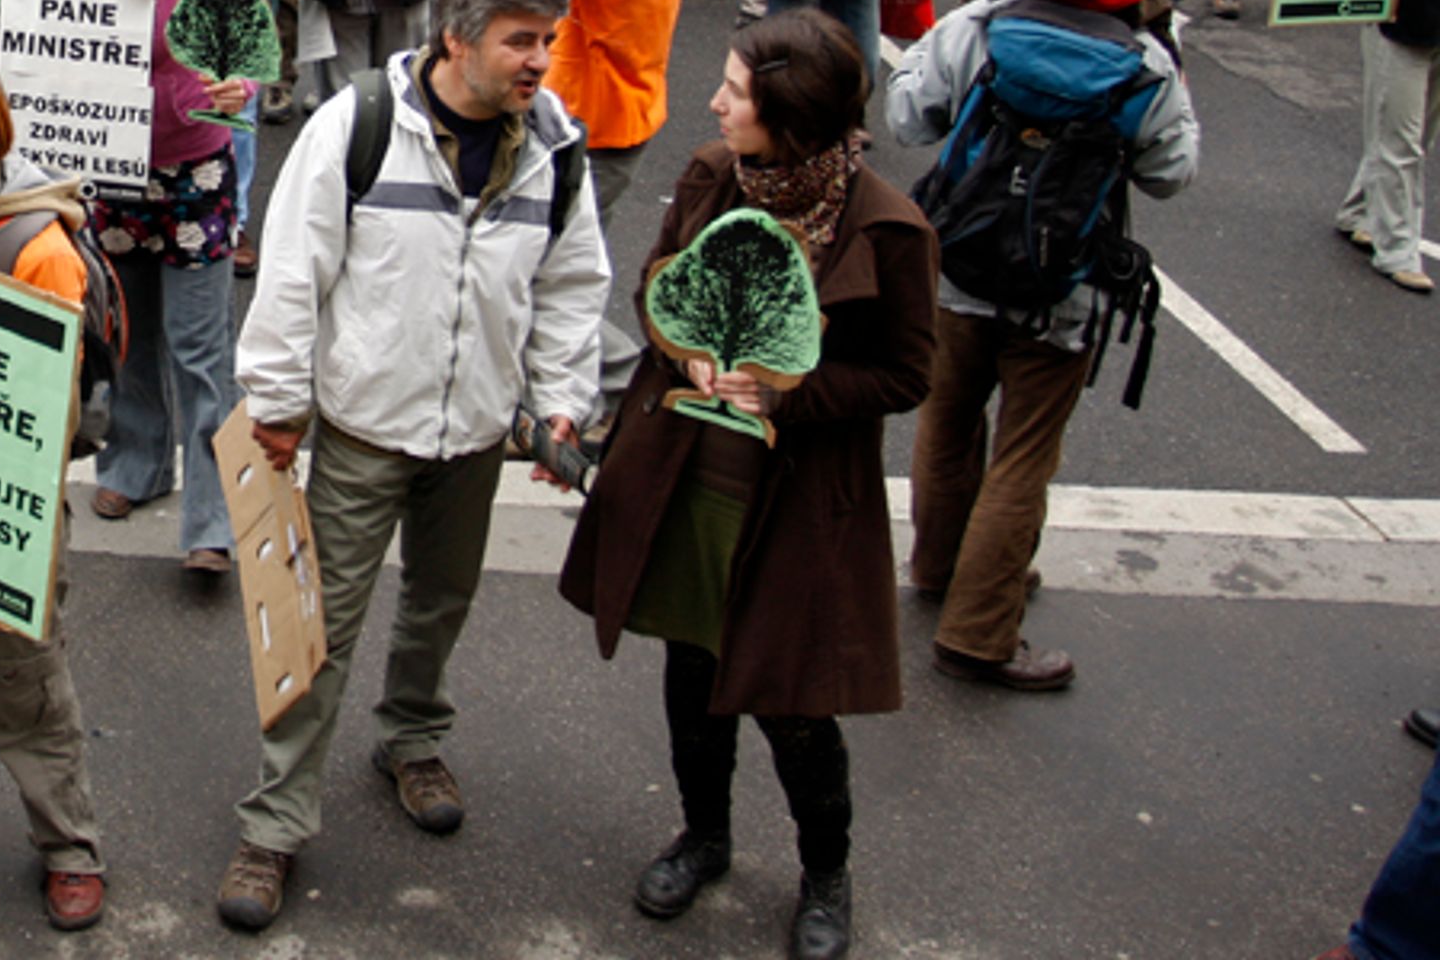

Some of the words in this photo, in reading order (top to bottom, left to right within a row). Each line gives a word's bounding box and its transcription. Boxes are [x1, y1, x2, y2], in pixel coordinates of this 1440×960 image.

[2, 31, 149, 71] MINISTŘE,
[10, 93, 152, 126] EPOŠKOZUJTE
[29, 121, 108, 148] ZDRAVÍ
[93, 157, 146, 178] LESŮ
